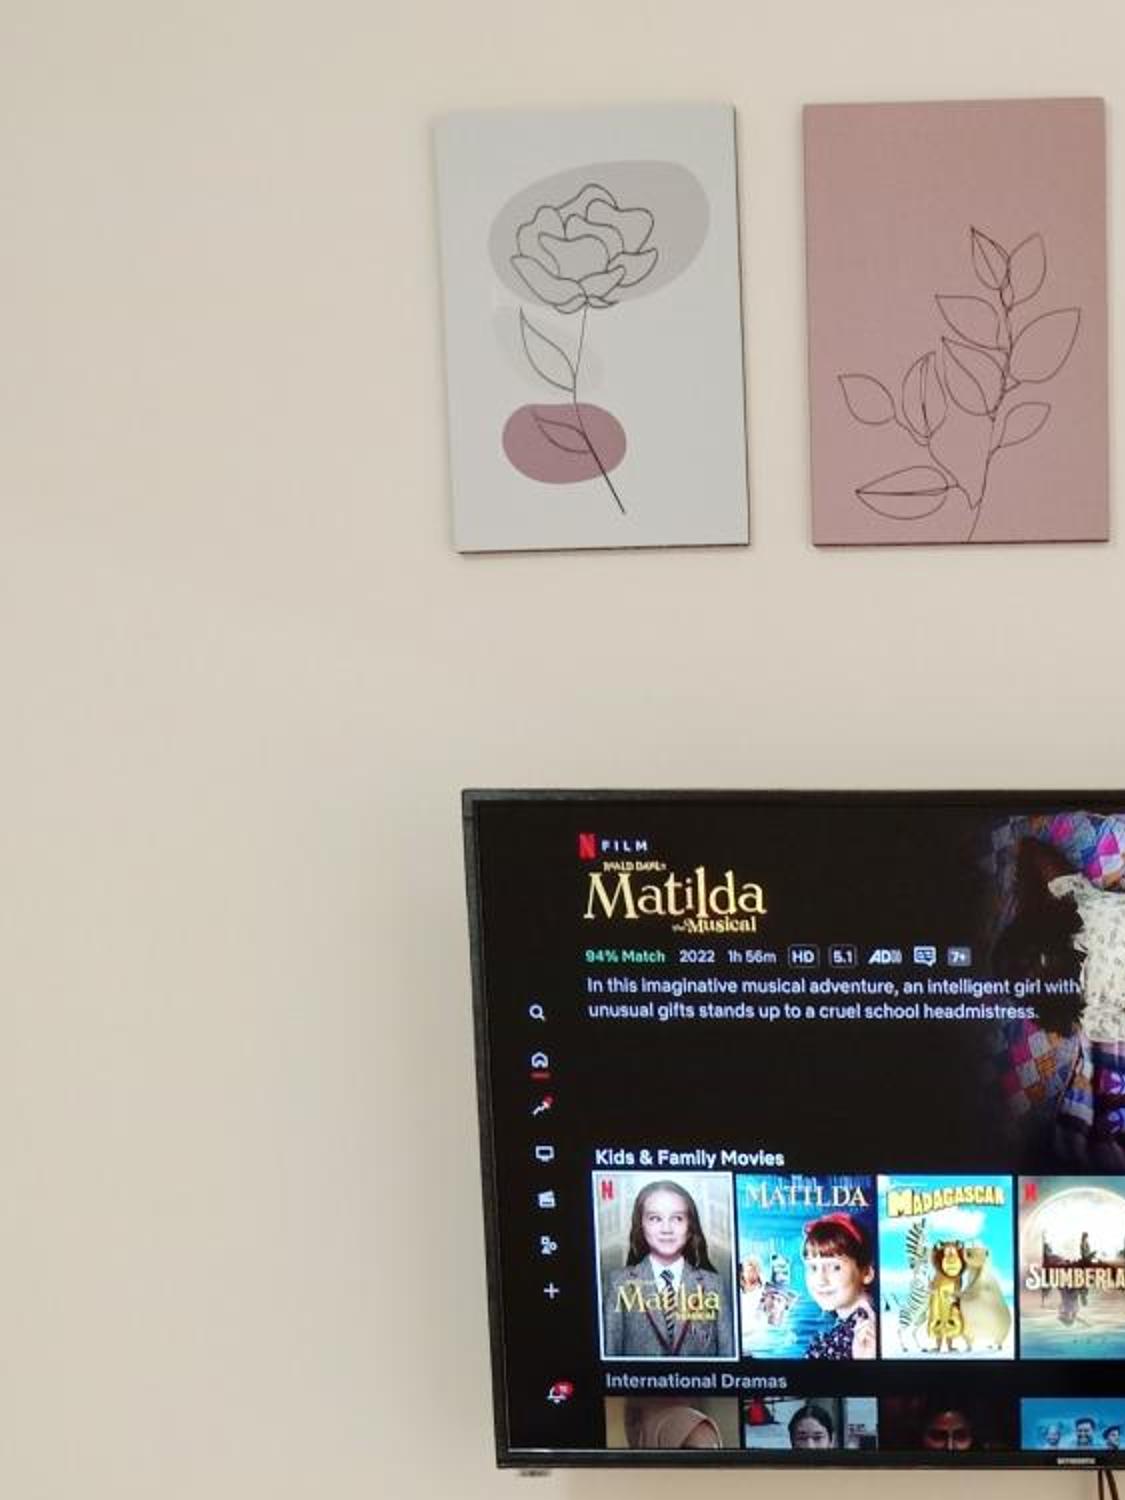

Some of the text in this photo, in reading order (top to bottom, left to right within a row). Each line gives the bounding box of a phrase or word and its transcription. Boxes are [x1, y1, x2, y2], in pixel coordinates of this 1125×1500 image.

[601, 840, 648, 852] FILM
[583, 866, 768, 920] Matilda
[685, 916, 758, 934] Musical
[585, 949, 619, 964] 94%
[621, 949, 666, 964] Match
[679, 949, 716, 964] 2022
[727, 949, 743, 964] 1h
[745, 949, 777, 964] 56m
[791, 950, 815, 964] HD
[833, 950, 853, 964] 5.1
[950, 950, 967, 963] 7+
[587, 977, 1081, 998] In this imaginative musical adventure, an intelligent girl with
[588, 1002, 1040, 1022] unusual gifts stands up to a cruel school headmistress.
[595, 1149, 785, 1169] Kids & Family Movies
[745, 1180, 869, 1209] MATILDA
[886, 1185, 1005, 1218] MADAGASCAR
[606, 1372, 788, 1389] International Dramas
